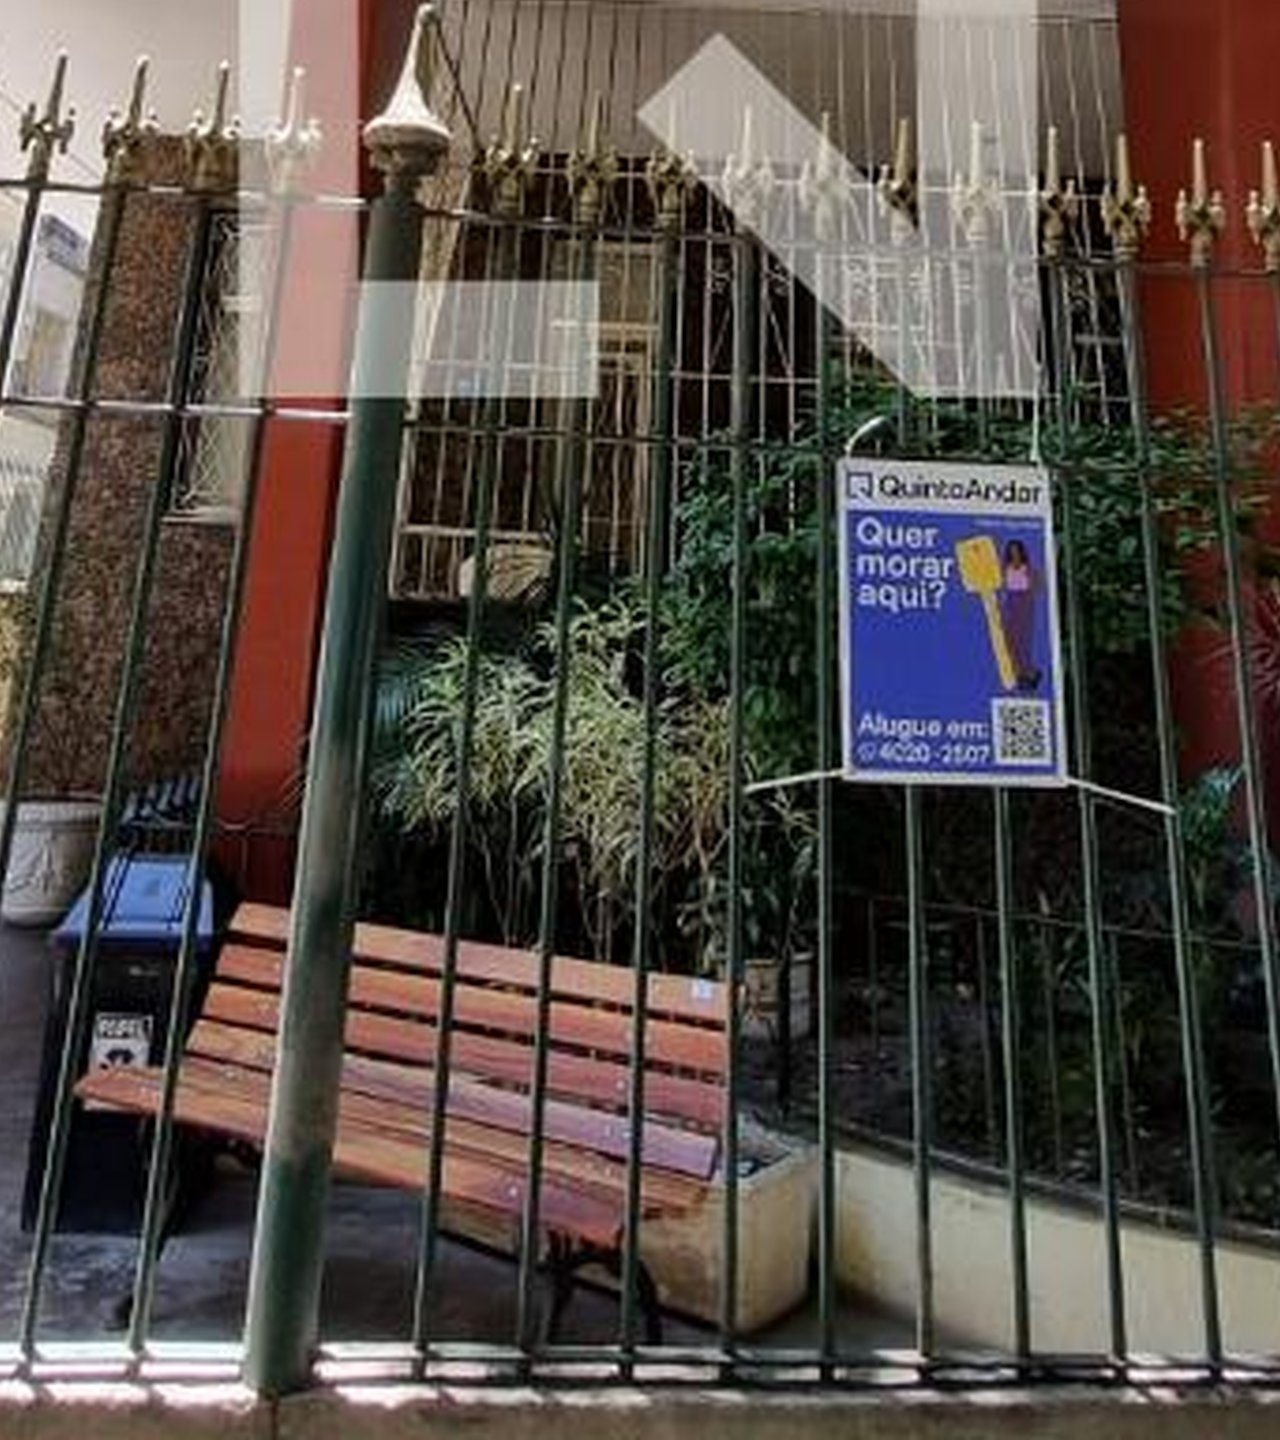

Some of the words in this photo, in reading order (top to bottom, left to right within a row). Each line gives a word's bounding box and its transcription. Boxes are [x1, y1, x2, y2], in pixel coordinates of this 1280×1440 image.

[879, 475, 1041, 503] QuintoAndar
[856, 516, 939, 548] Quer
[856, 553, 952, 579] morar
[857, 580, 946, 612] aqui?
[858, 713, 941, 741] Alugue
